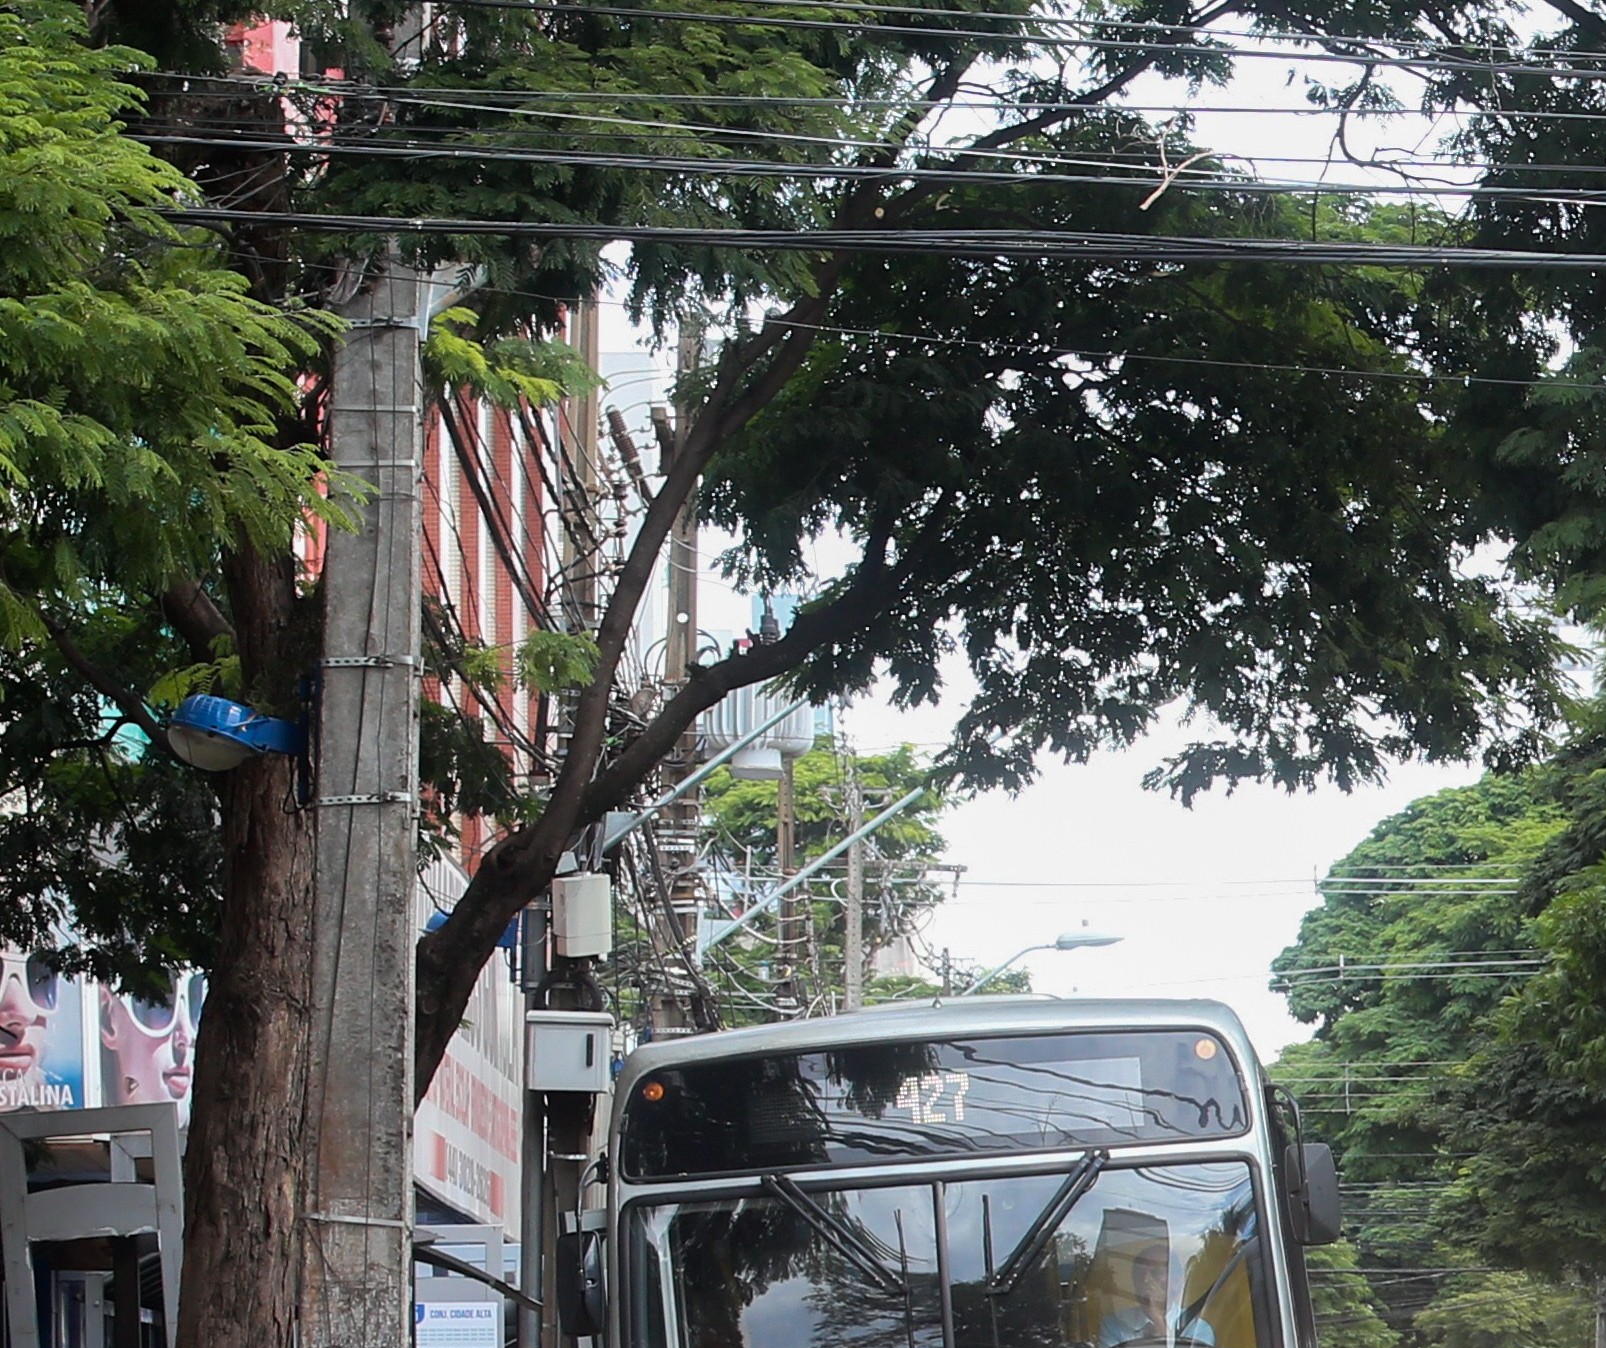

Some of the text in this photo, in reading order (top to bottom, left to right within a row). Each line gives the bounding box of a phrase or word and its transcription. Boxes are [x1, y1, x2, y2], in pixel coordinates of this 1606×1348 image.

[896, 1073, 970, 1125] 427
[449, 1309, 474, 1319] CIDADE
[475, 1309, 492, 1319] ALTA
